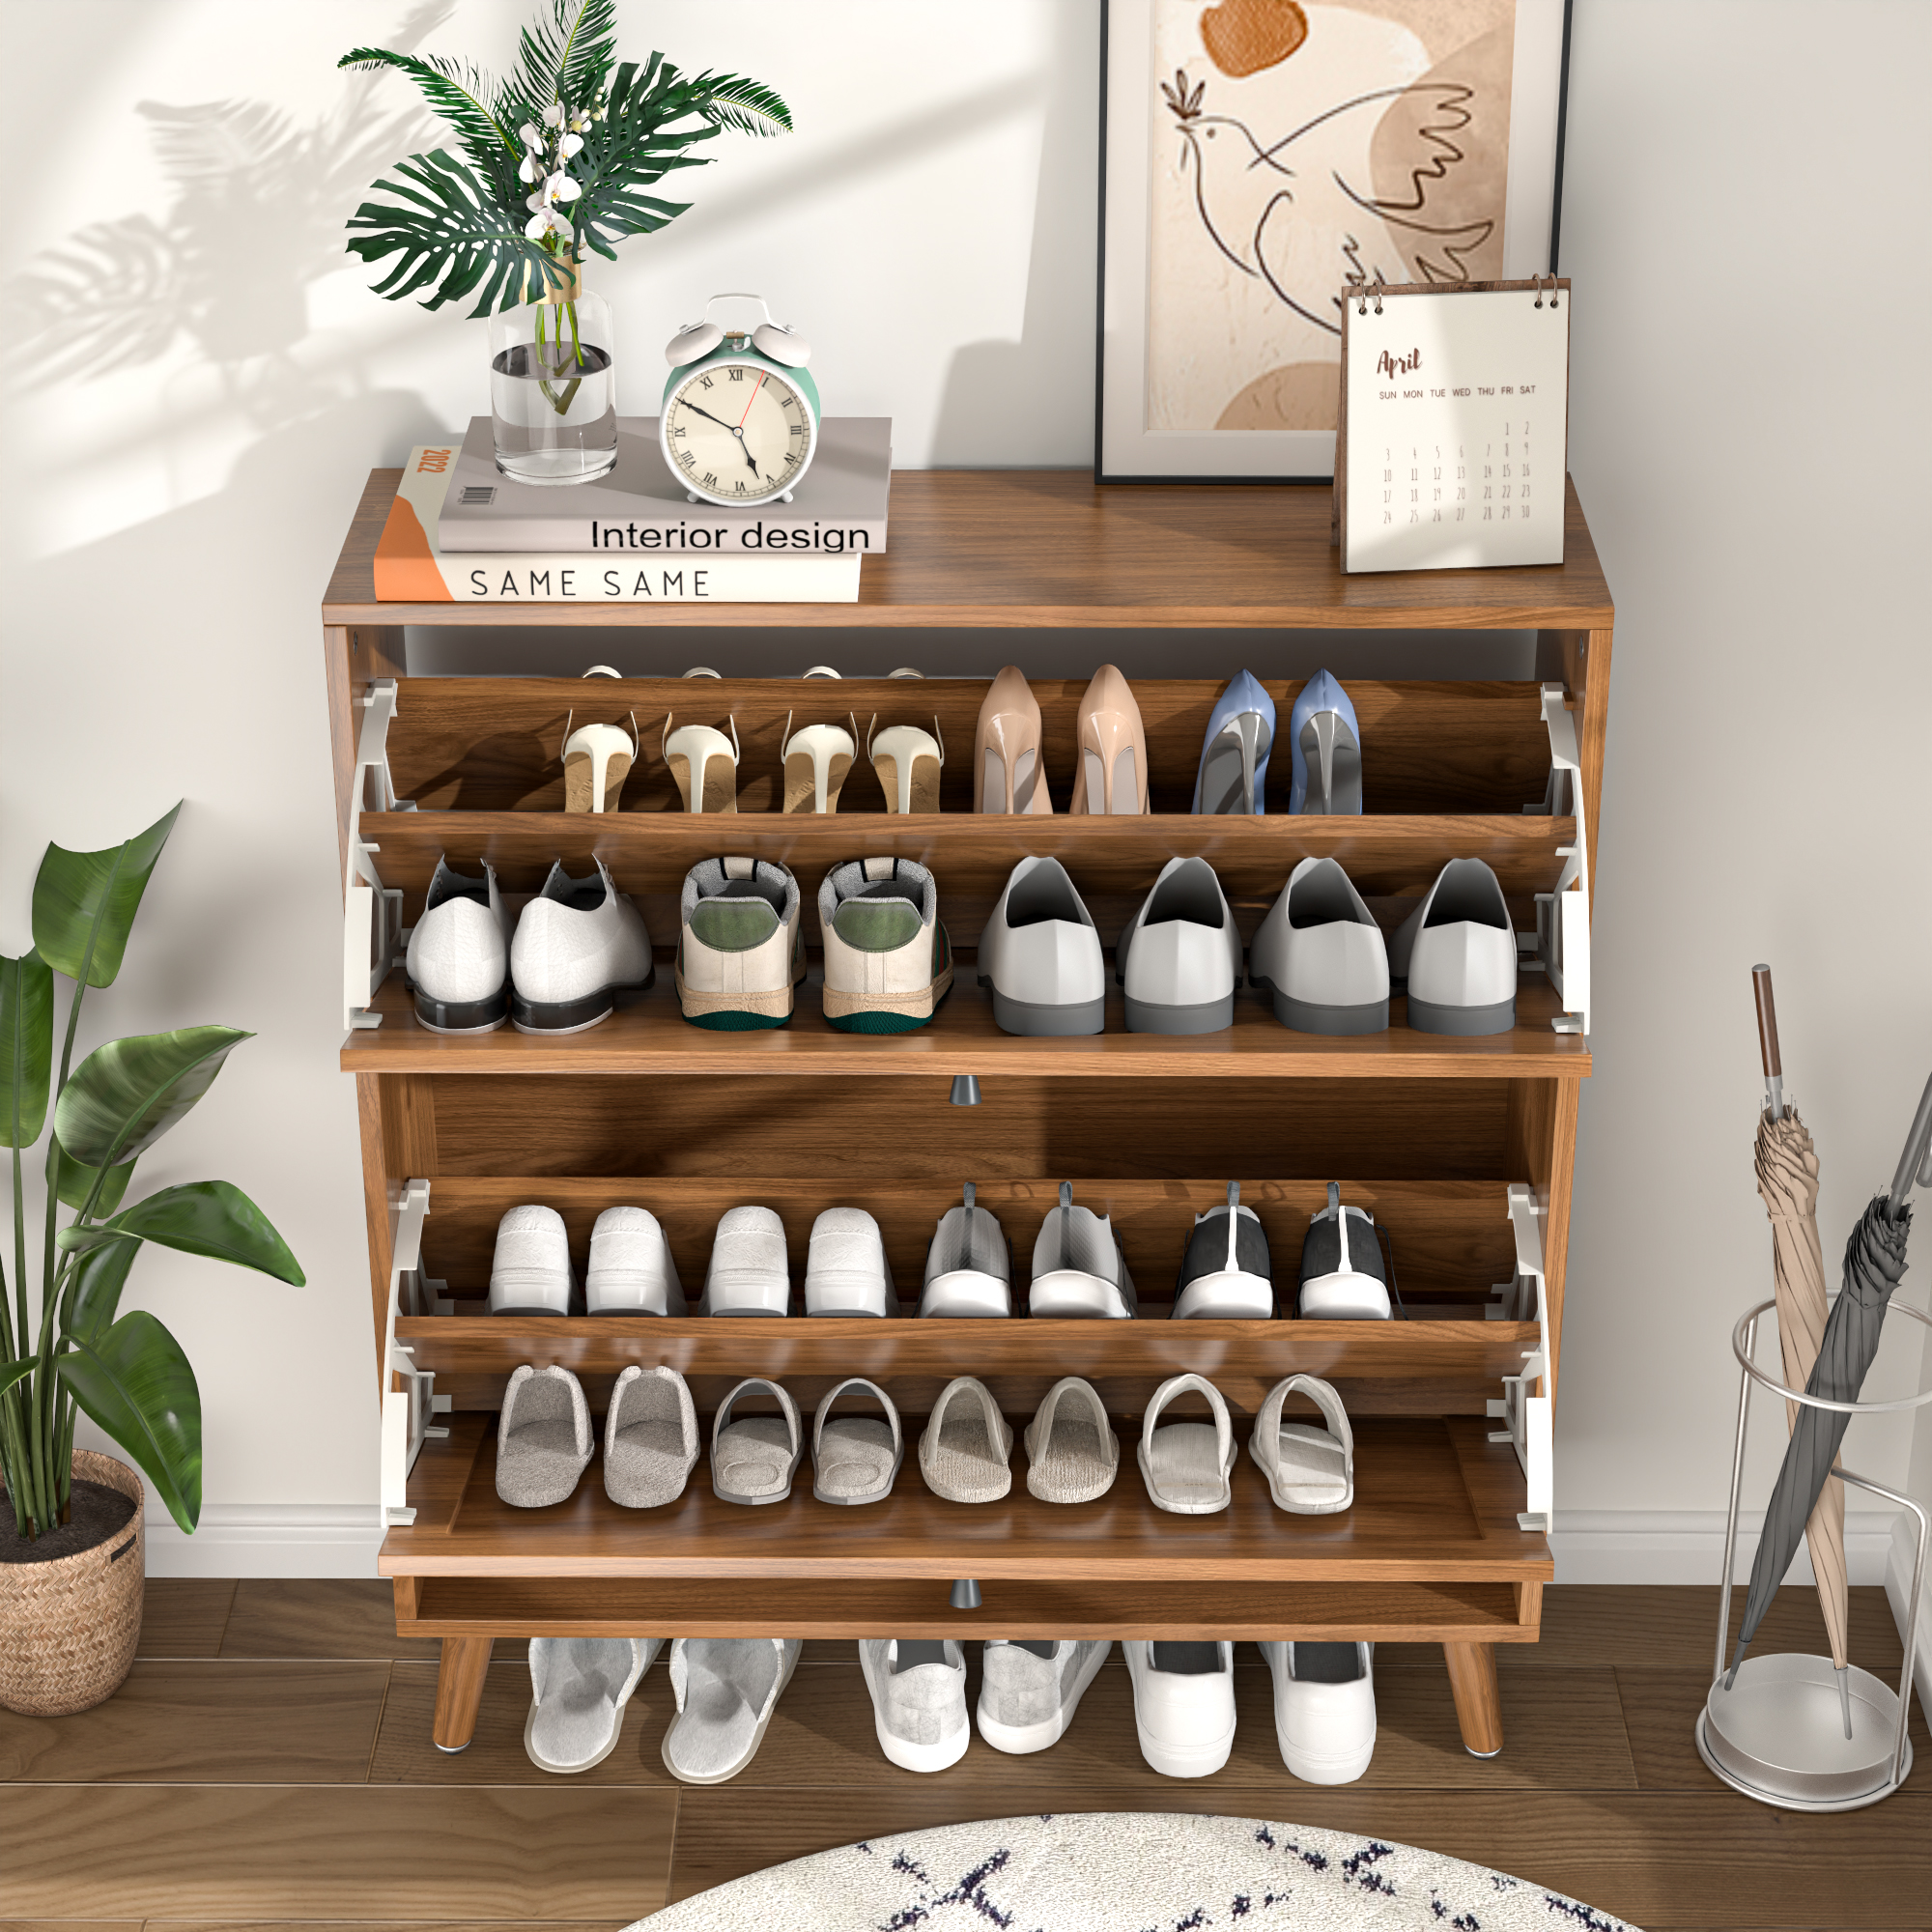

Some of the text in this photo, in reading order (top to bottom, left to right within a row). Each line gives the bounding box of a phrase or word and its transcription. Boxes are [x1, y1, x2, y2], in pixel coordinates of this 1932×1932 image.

[1376, 348, 1422, 380] April
[699, 376, 714, 390] XI
[728, 369, 743, 382] XII
[1378, 384, 1536, 401] SUN MON TUE WED THU FRI SAT
[781, 397, 793, 409] II
[674, 427, 686, 438] IX
[790, 425, 802, 436] III
[1505, 420, 1530, 437] 1 2
[416, 449, 452, 473] 2022
[680, 450, 696, 469] VIII
[783, 452, 796, 465] IV
[703, 472, 718, 486] VII
[766, 473, 775, 484] V
[1383, 463, 1531, 483] 10 11 12 13 14 15 16
[735, 481, 746, 491] VI
[1383, 483, 1531, 504] 17 18 19 20 21 22 23
[1383, 504, 1530, 525] 24 25 26 27 28 29 30
[591, 521, 870, 554] Interior design
[470, 570, 709, 596] SAME SAME
